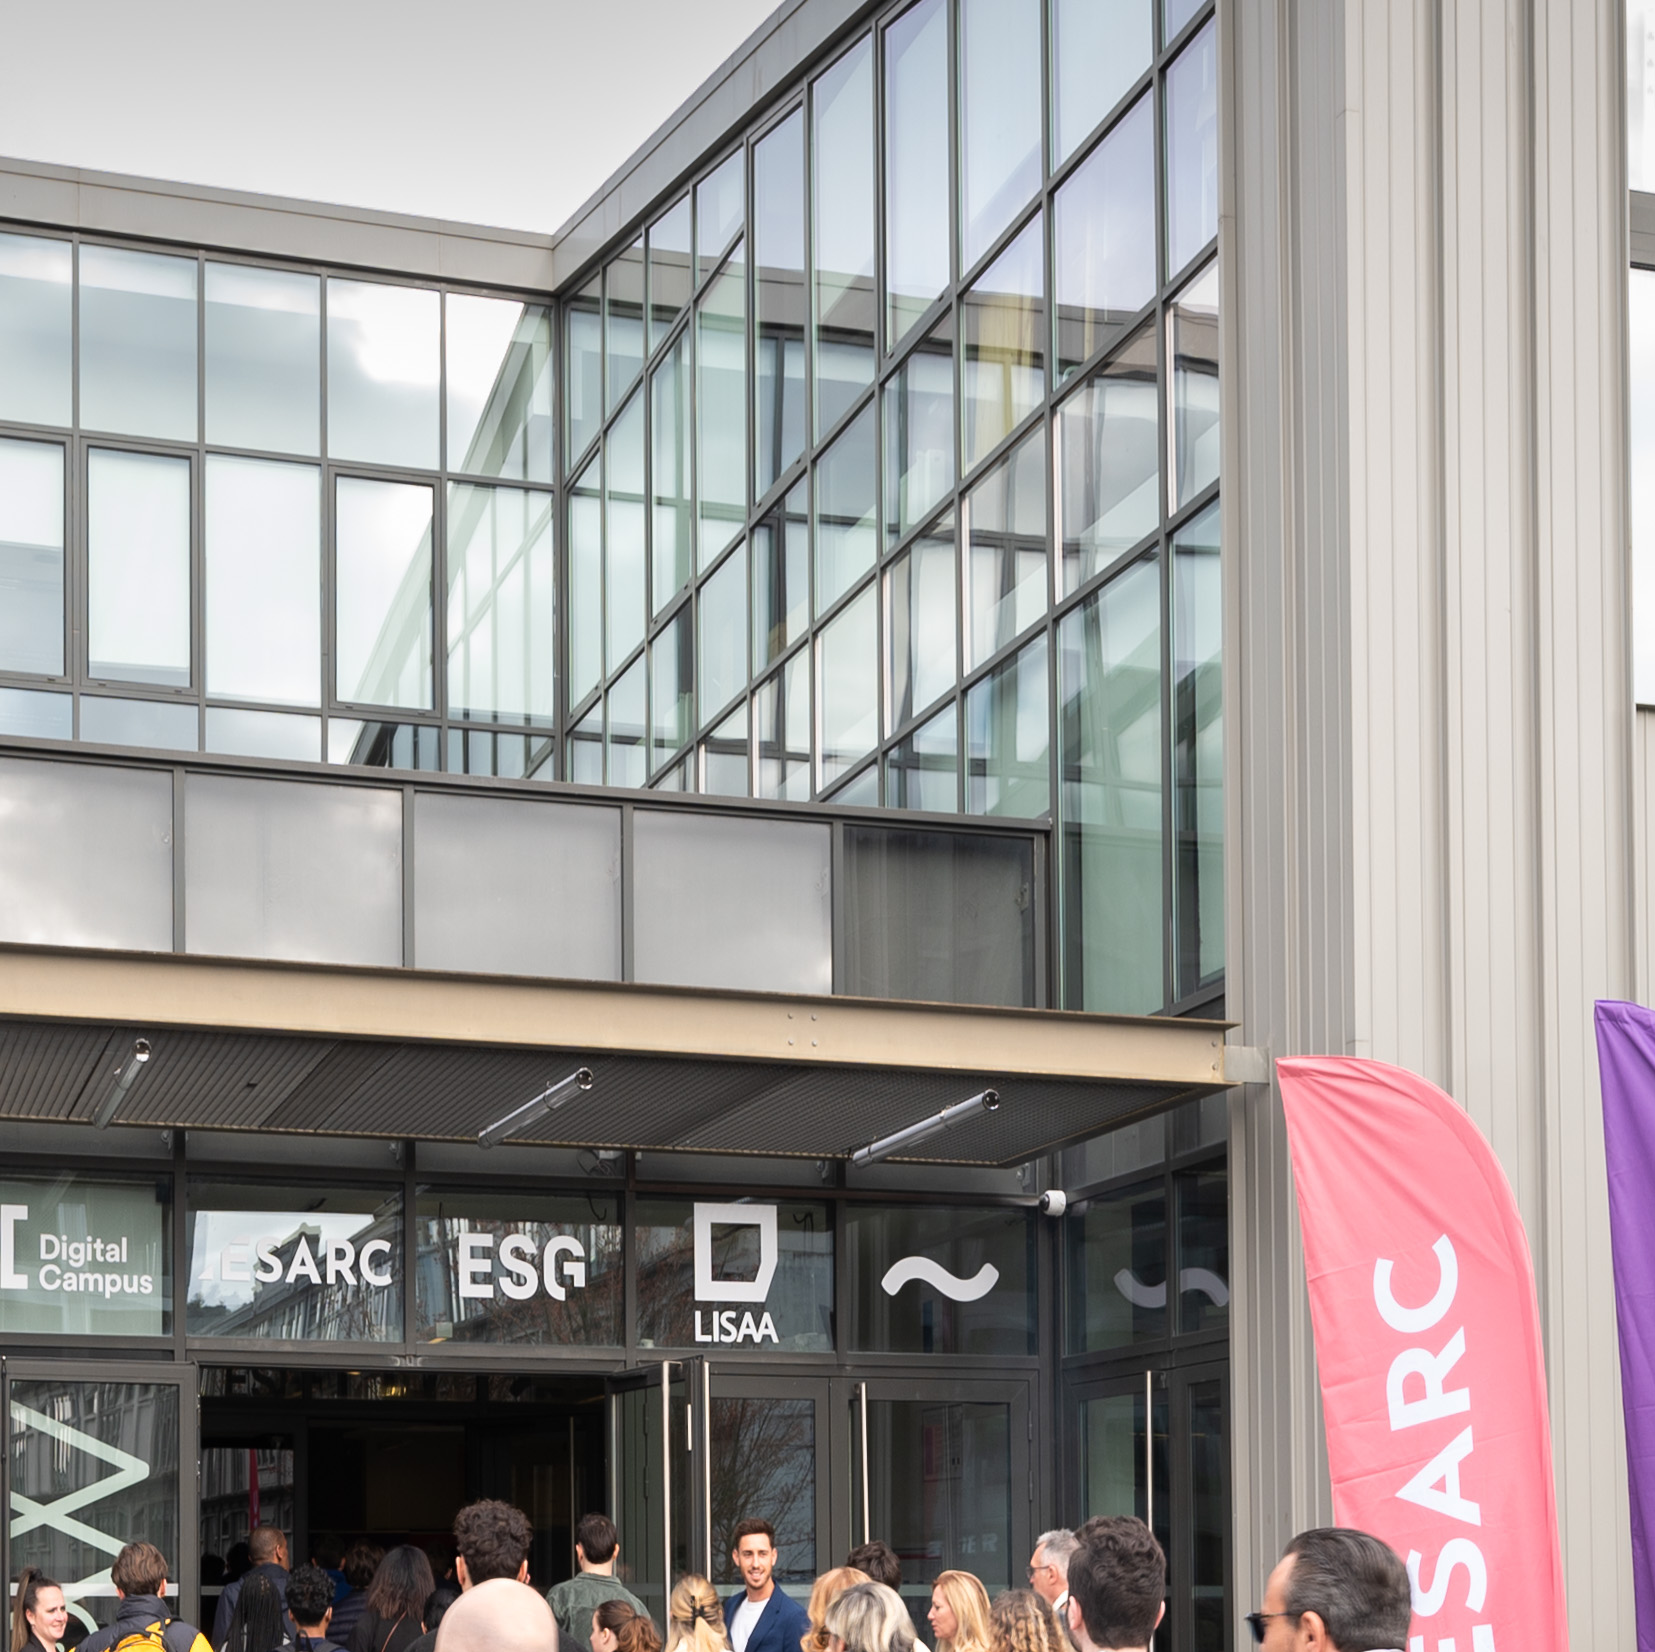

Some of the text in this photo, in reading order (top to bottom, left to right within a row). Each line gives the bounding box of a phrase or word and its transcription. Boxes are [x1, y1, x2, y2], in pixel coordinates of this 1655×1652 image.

[39, 1233, 128, 1268] Digital
[221, 1235, 393, 1288] ESARC
[458, 1232, 586, 1301] ESG
[38, 1263, 154, 1300] Campus
[694, 1310, 780, 1344] LISAA
